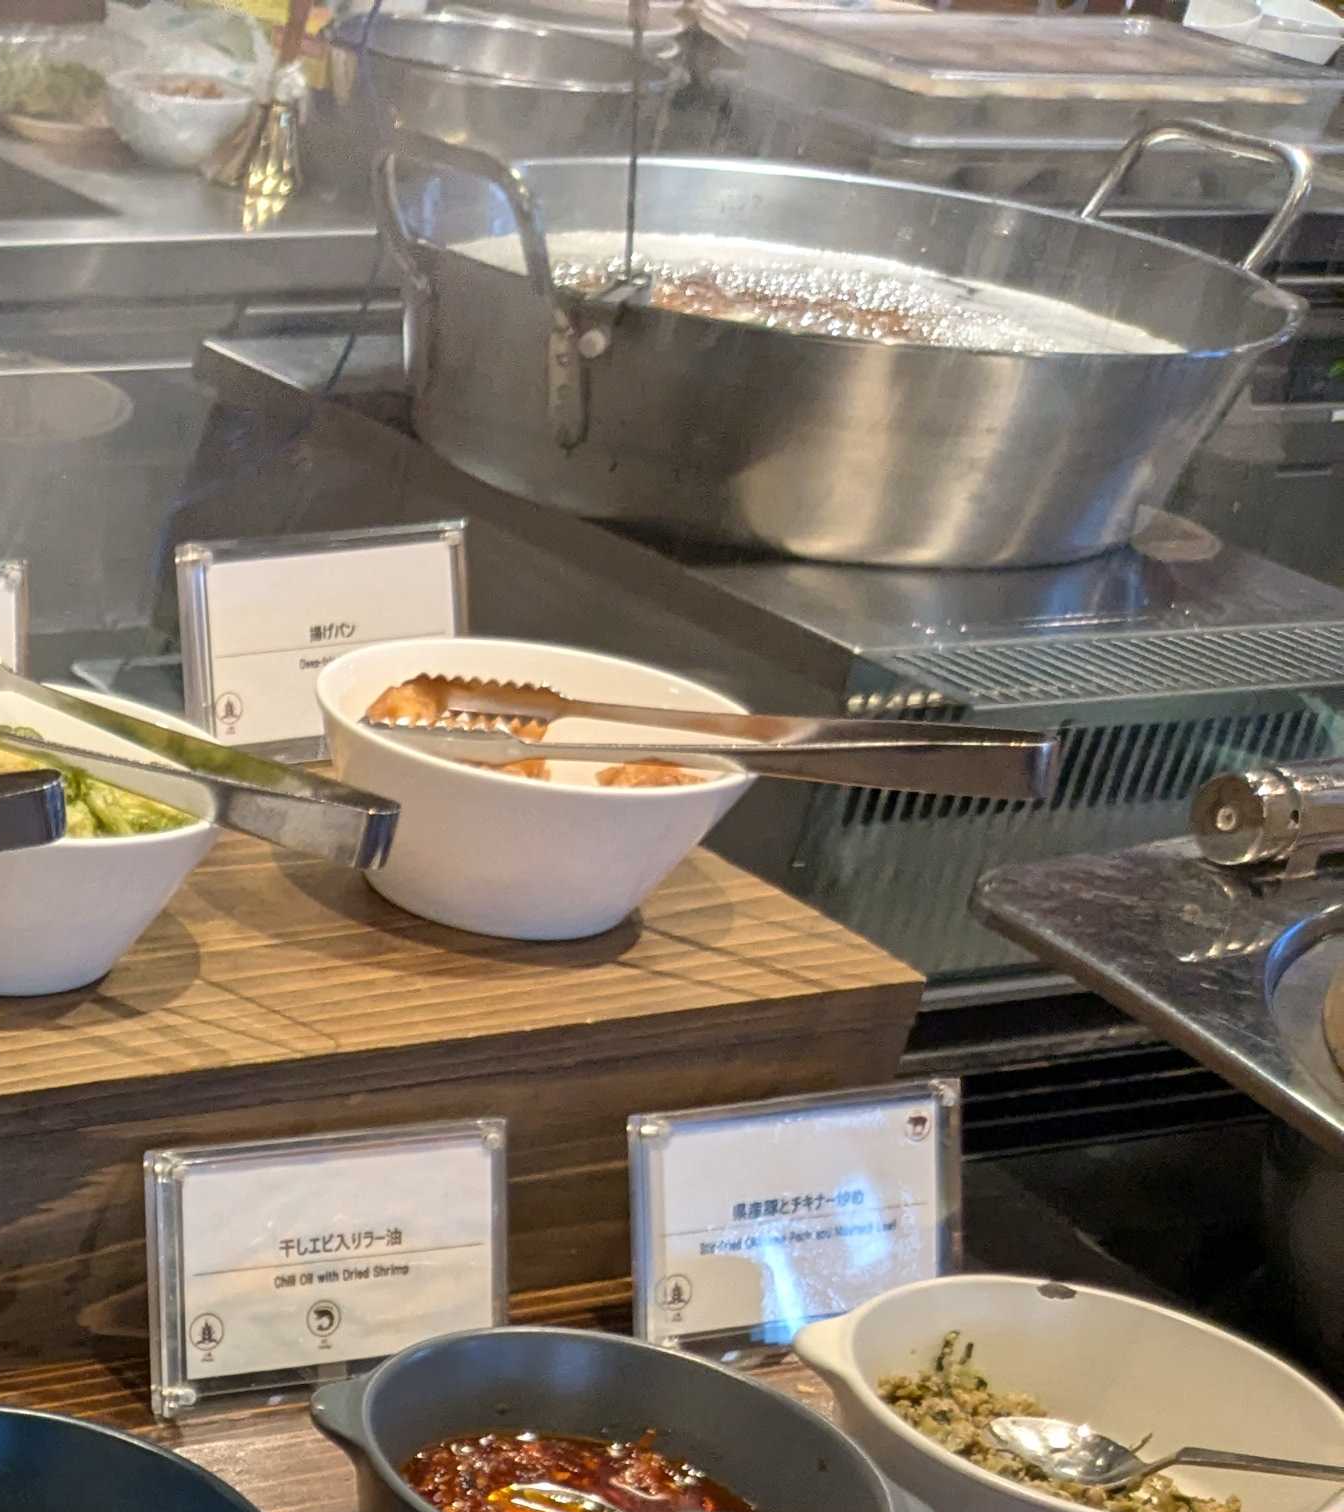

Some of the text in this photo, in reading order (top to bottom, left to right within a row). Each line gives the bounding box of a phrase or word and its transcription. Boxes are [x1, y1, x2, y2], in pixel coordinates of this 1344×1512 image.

[278, 1228, 403, 1258] 干しエビ入りラー油
[317, 1271, 339, 1283] with
[342, 1267, 370, 1282] Dried
[373, 1264, 410, 1279] Shrimp
